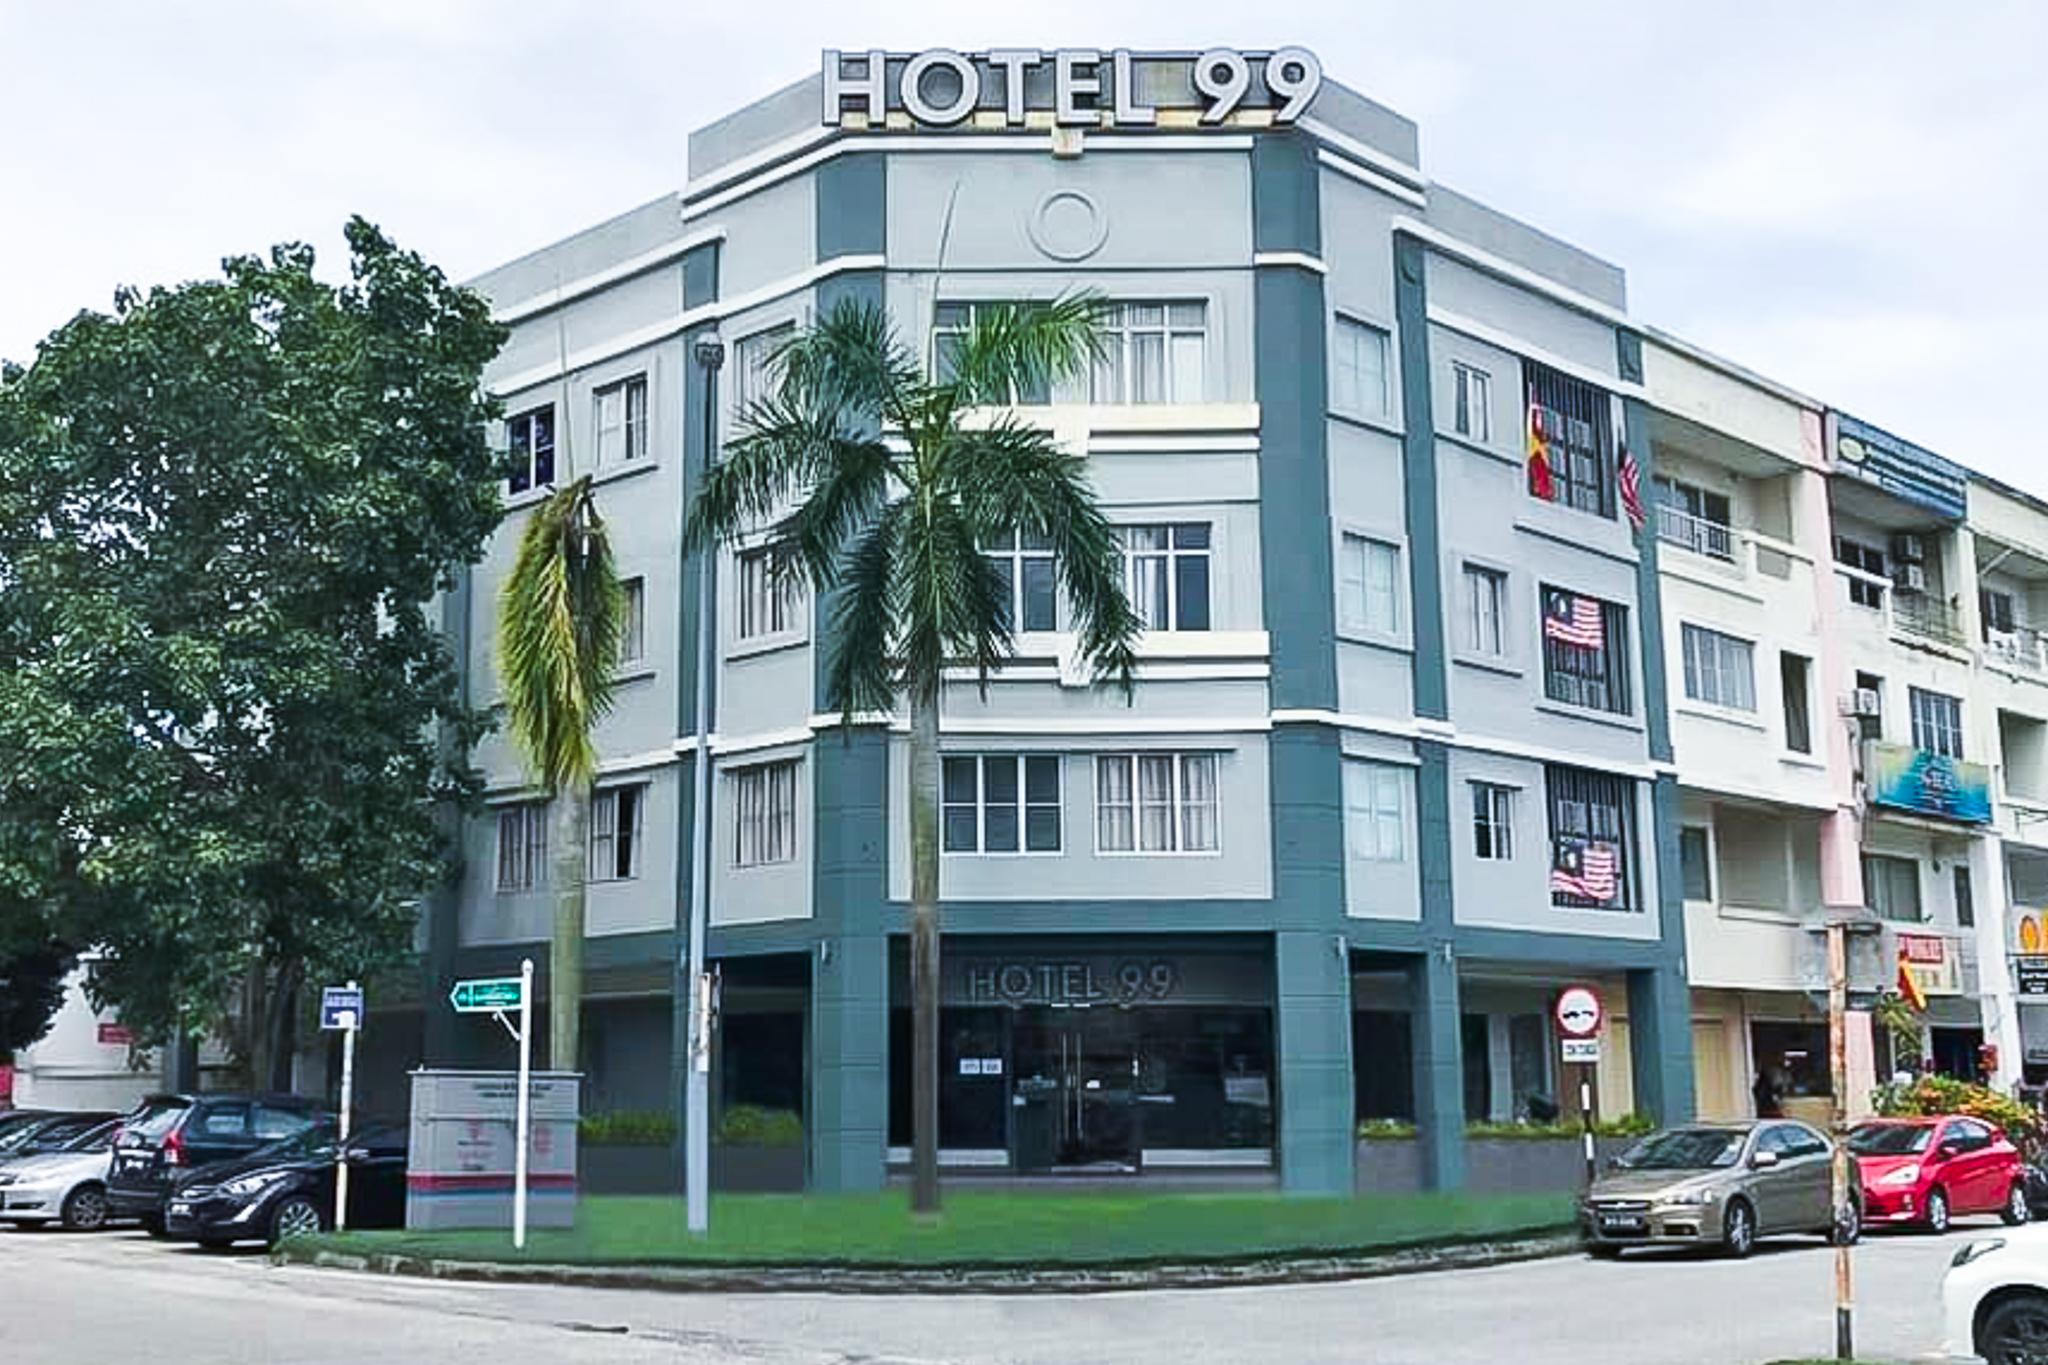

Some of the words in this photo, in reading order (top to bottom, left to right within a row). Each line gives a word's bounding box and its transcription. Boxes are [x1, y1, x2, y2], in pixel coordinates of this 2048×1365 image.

[822, 48, 1156, 128] HOTEL
[1192, 46, 1323, 127] 99
[969, 964, 1102, 1000] HOTEL
[1119, 963, 1173, 999] 99
